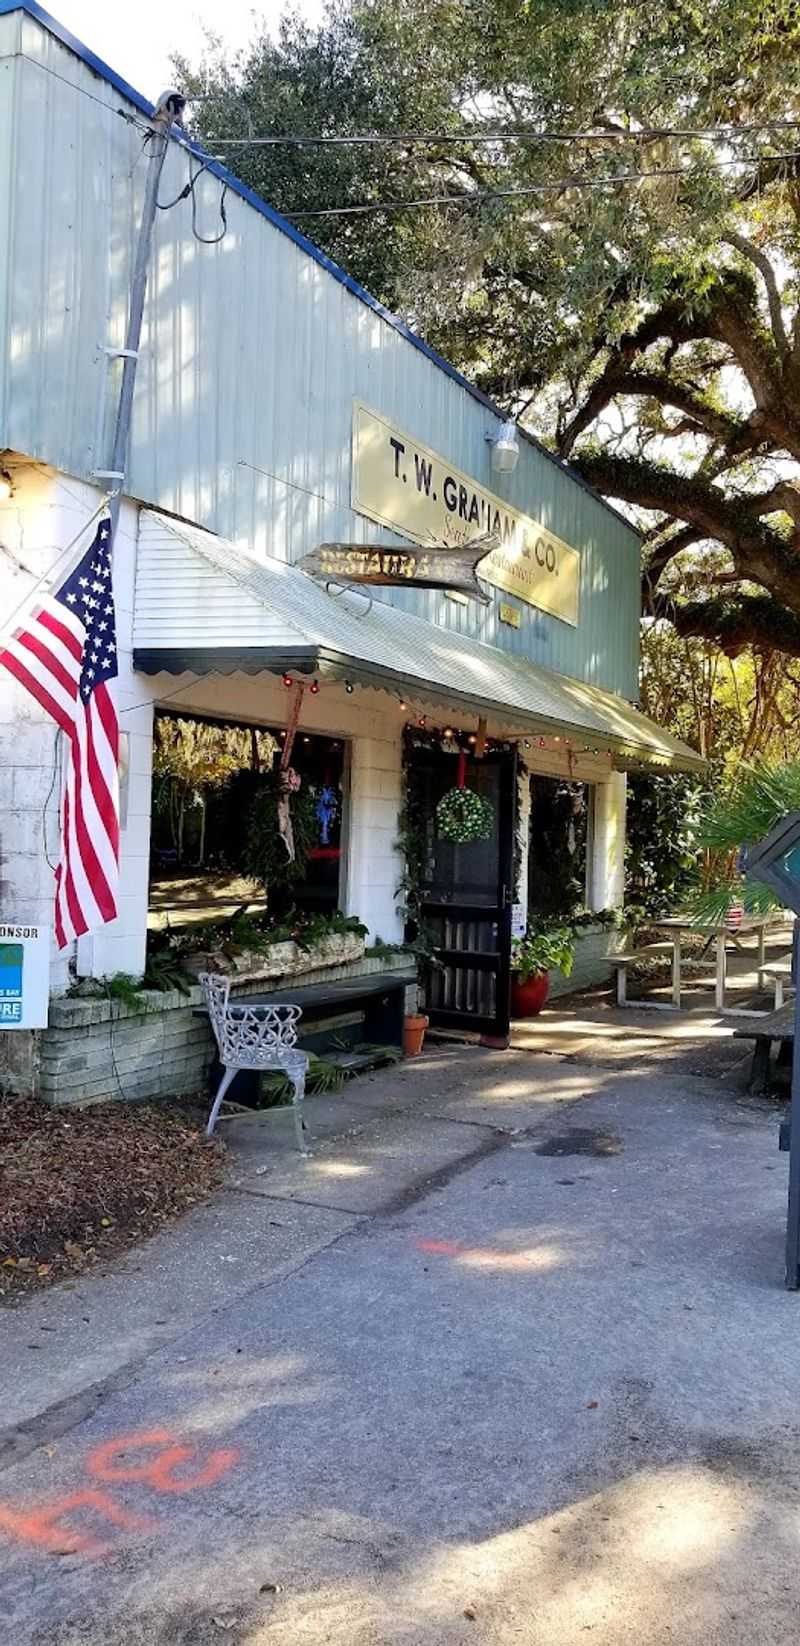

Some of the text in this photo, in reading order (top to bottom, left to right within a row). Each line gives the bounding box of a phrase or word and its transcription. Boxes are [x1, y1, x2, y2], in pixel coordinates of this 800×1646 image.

[390, 437, 407, 483] T.
[414, 453, 437, 501] W.
[535, 537, 560, 576] CO.
